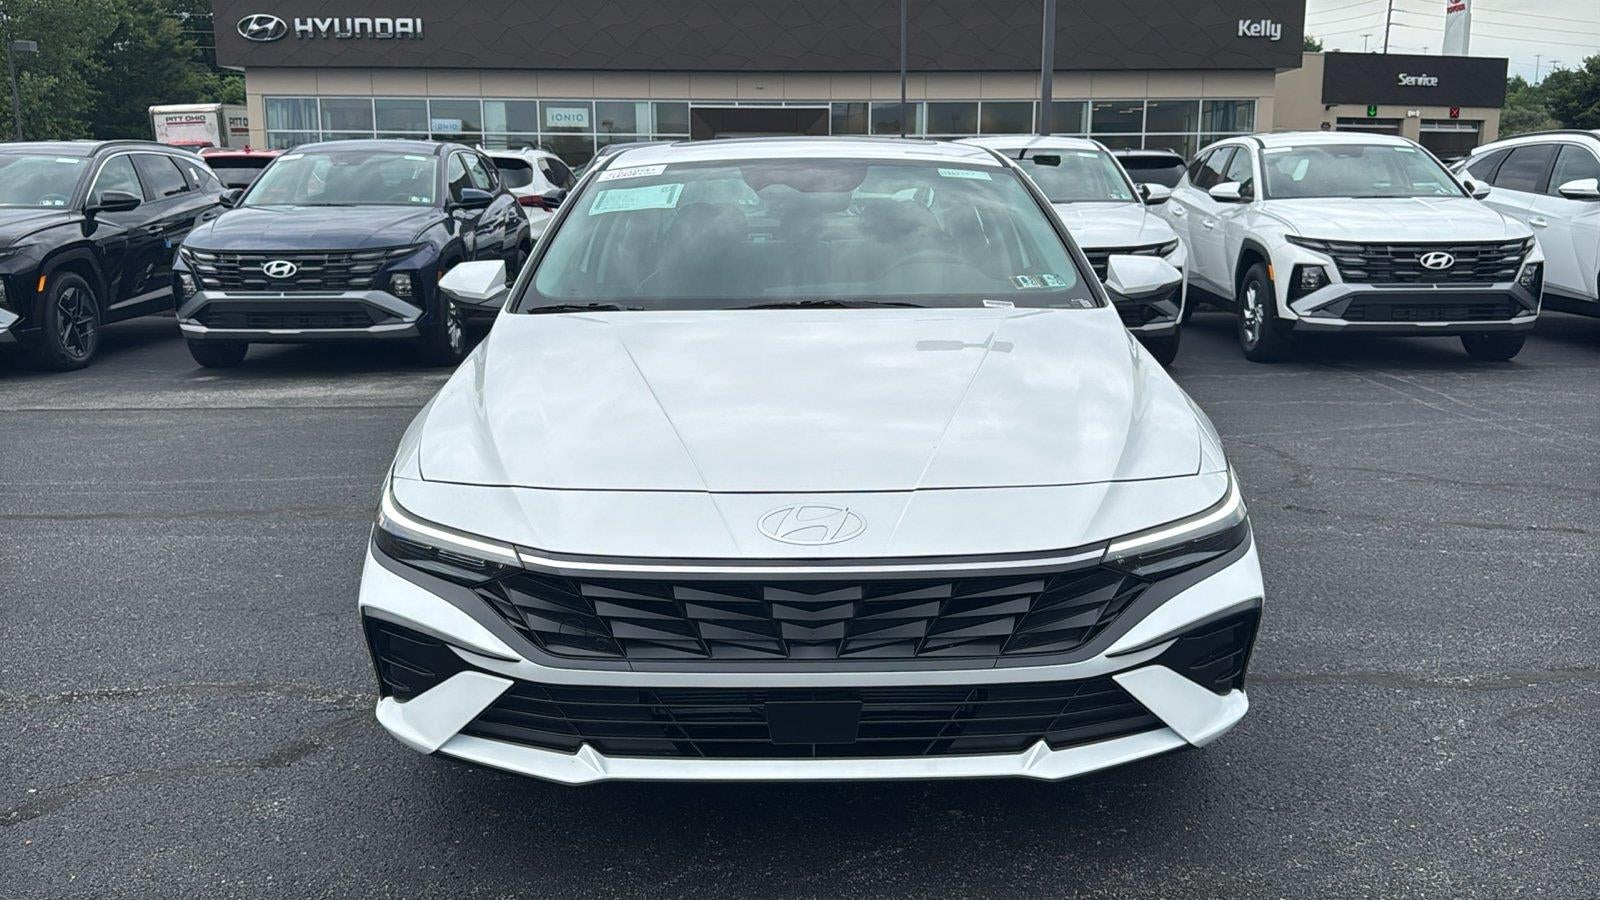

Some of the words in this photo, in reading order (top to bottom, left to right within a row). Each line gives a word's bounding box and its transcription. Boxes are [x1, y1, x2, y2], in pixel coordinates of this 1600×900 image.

[294, 17, 424, 40] HYUNDAI
[1238, 19, 1282, 41] Kelly
[1398, 73, 1439, 87] Service
[185, 114, 206, 122] OHIO
[551, 113, 584, 122] IONIQ
